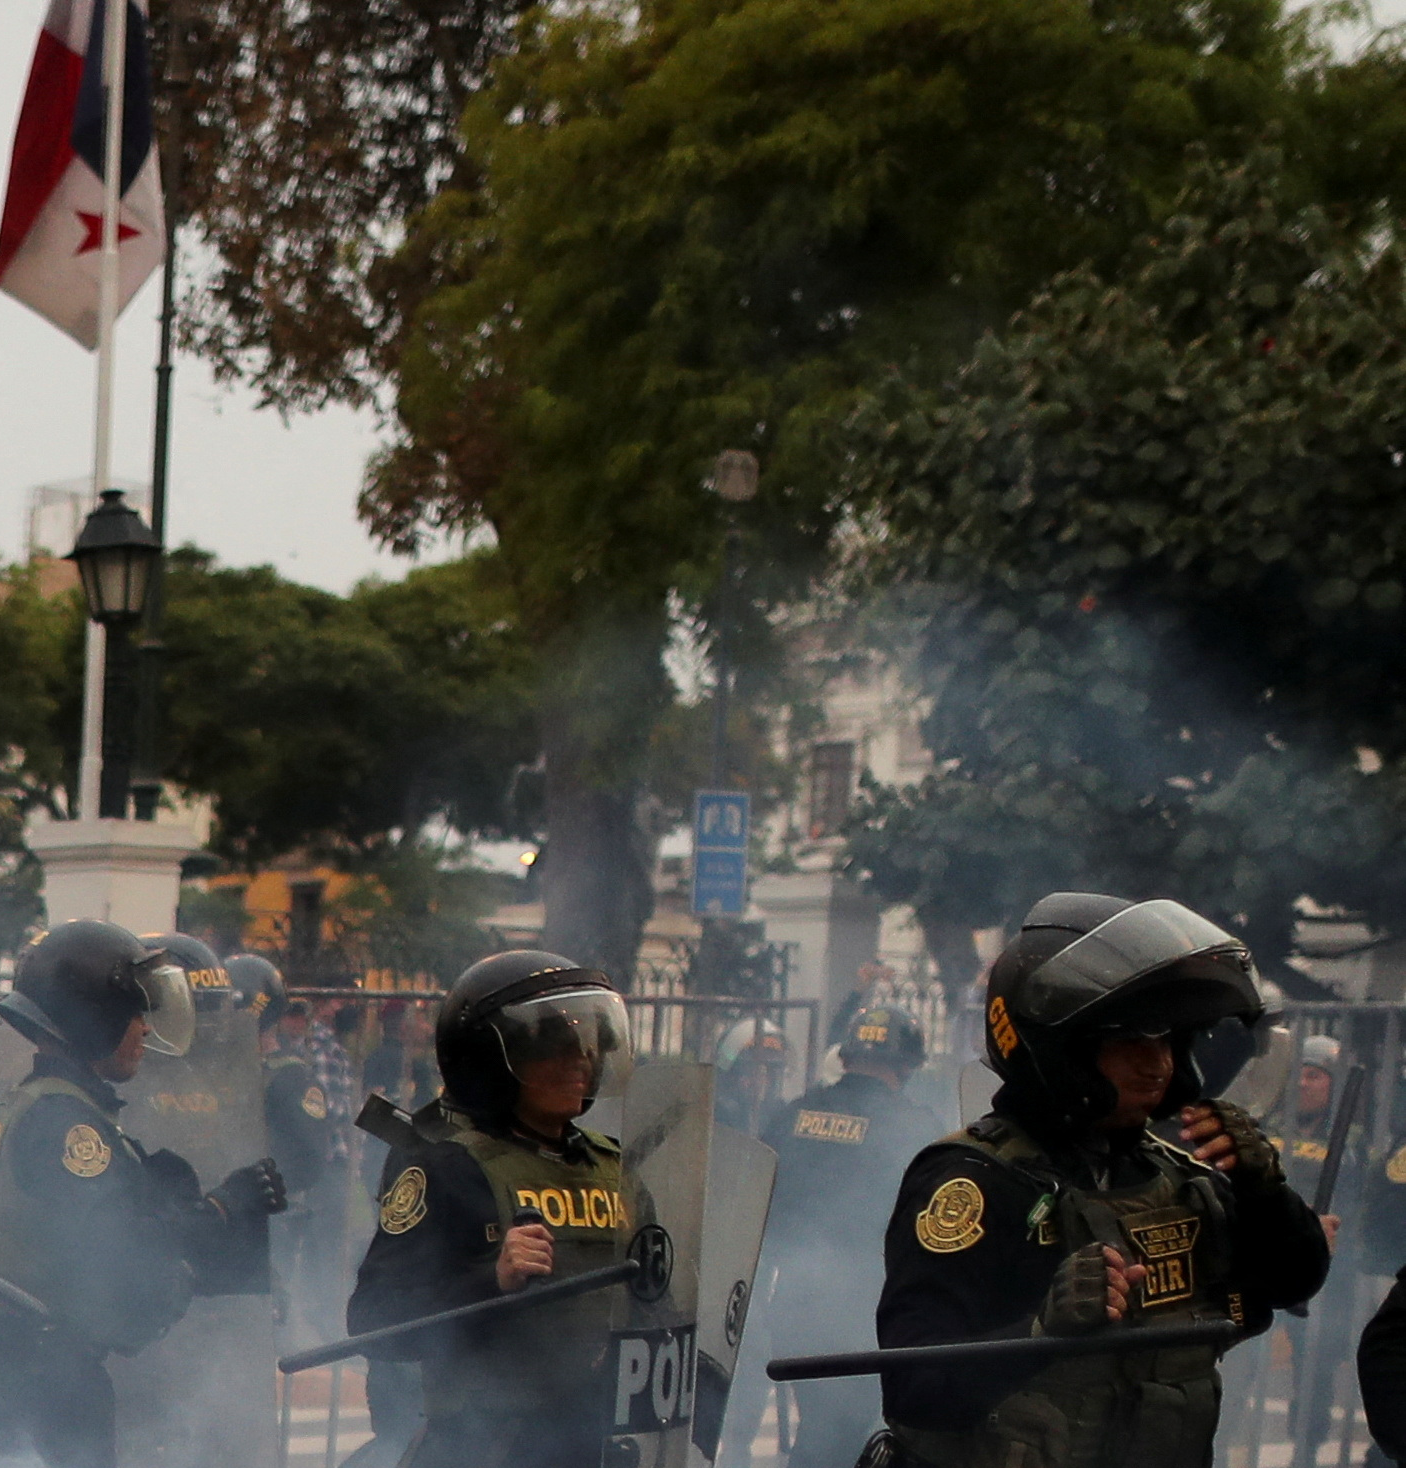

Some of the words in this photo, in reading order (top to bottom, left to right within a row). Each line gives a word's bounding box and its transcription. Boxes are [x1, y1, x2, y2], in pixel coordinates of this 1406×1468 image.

[989, 996, 1019, 1059] GIR
[799, 1115, 866, 1140] POLICIA
[516, 1188, 629, 1229] POLICIA
[1145, 1258, 1186, 1297] GIR
[1228, 1293, 1245, 1327] PER
